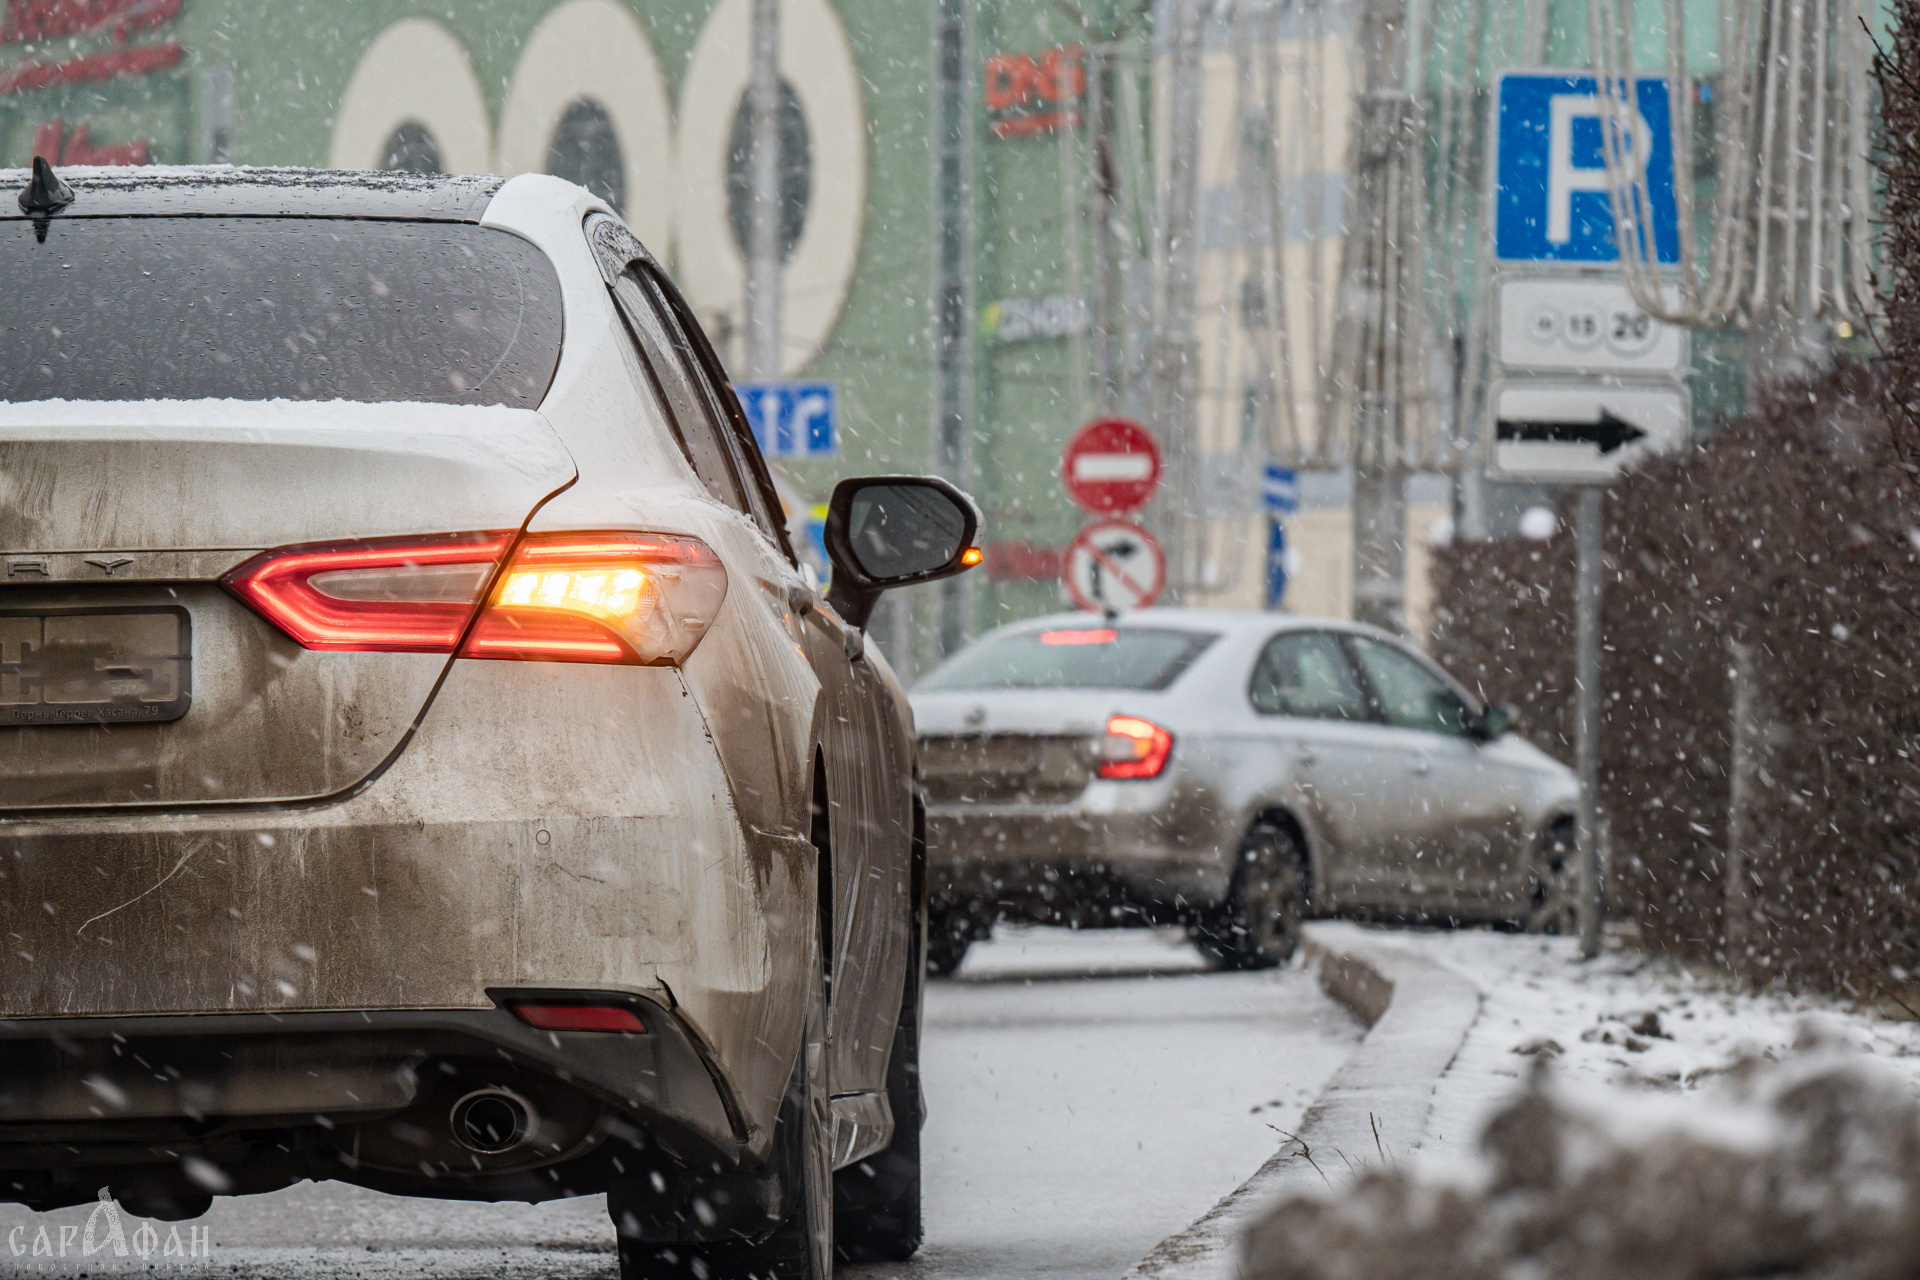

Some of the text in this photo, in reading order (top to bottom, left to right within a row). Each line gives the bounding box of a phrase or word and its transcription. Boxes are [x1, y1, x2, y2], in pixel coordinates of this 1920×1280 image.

[1545, 94, 1653, 243] P
[1613, 312, 1650, 341] 20
[55, 707, 94, 720] Героев
[99, 706, 142, 718] Хасана,
[144, 704, 160, 716] 79
